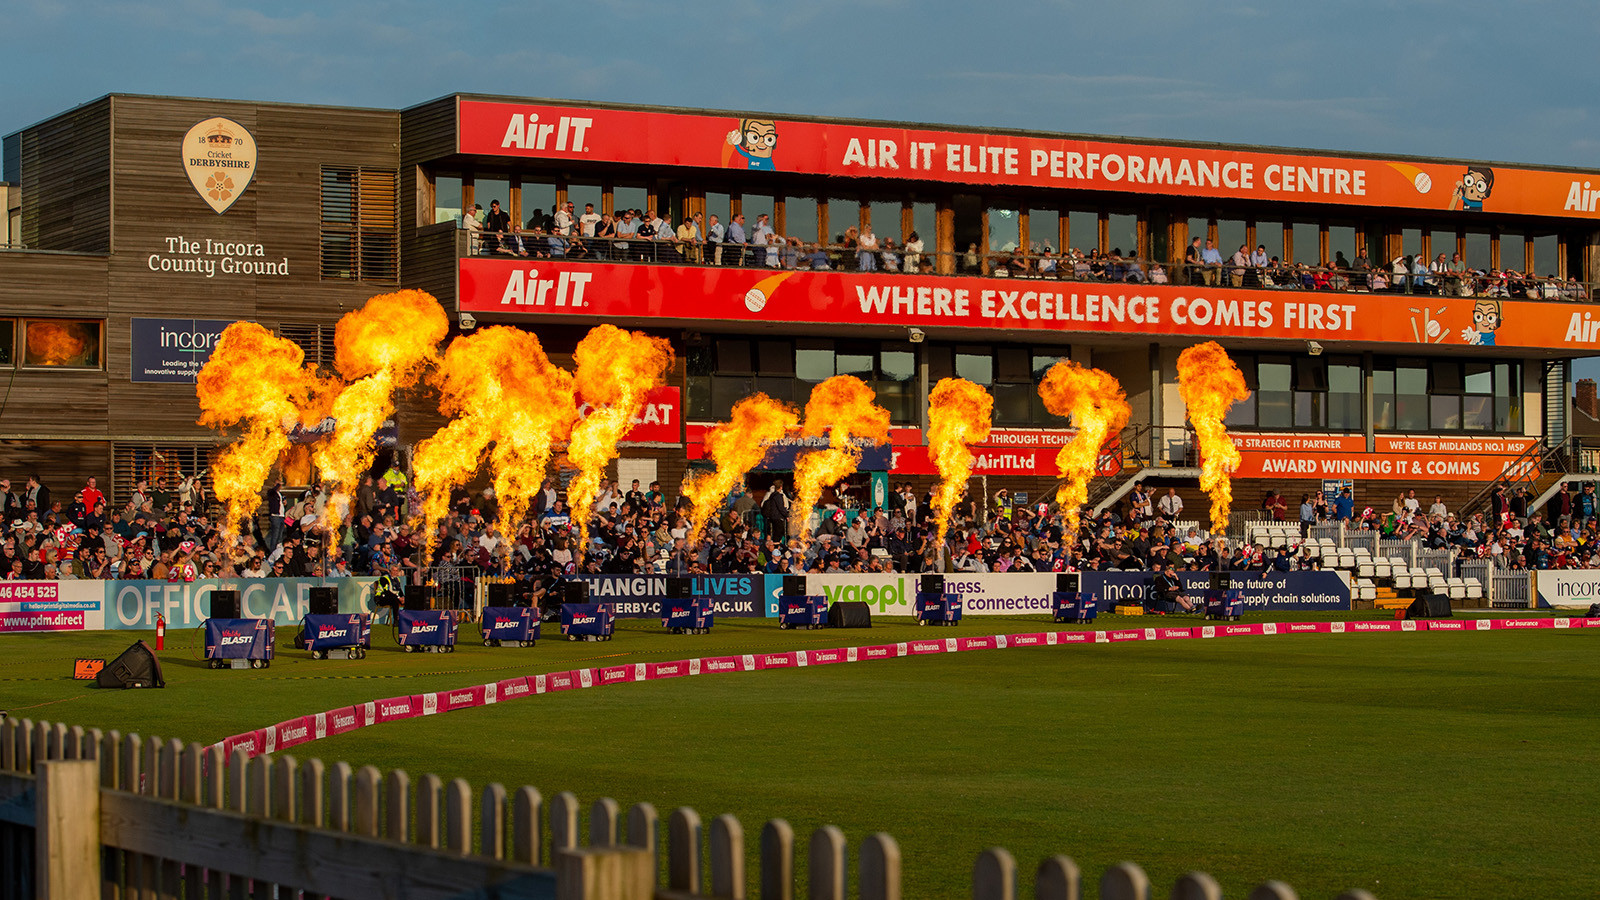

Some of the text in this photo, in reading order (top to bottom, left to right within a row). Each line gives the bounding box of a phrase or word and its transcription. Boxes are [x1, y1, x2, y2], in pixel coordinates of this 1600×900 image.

[198, 136, 206, 144] 18
[207, 151, 232, 159] Cricket
[190, 159, 250, 168] DERBYSHIRE
[842, 138, 1366, 196] AIR IT ELITE PERFORMANCE CENTRE
[165, 236, 265, 257] The Incora
[148, 254, 289, 277] County Ground
[856, 285, 1356, 330] WHERE EXCELLENCE COMES FIRST
[162, 360, 187, 369] Leading
[189, 359, 199, 367] the
[177, 368, 197, 377] supply
[991, 434, 1072, 445] THROUGH TECHN
[1246, 439, 1291, 448] STRATEGIC
[1293, 439, 1300, 448] IT
[1303, 440, 1341, 449] PARTNER
[1390, 441, 1525, 452] WE'RE EAST MIDLANDS NO.1 MSP
[1262, 459, 1480, 475] AWARD WINNING IT & COMMS
[1038, 503, 1046, 512] 4
[57, 529, 65, 542] 6
[1054, 559, 1061, 571] 6
[184, 565, 193, 578] 6
[570, 577, 752, 596] HANGIN LIVES
[915, 578, 985, 593] biness.
[1187, 578, 1287, 589] Lead the future of
[1557, 578, 1600, 596] incor
[14, 586, 35, 598] 454
[37, 586, 57, 598] 525
[117, 583, 238, 626] OFFIC
[967, 594, 1053, 611] connected.
[1244, 593, 1341, 606] upply chain solutions
[28, 602, 96, 611] hello@printdigitalmedia.co.uk
[671, 610, 691, 618] BLAST!
[3, 612, 83, 628] www.pdm.direct
[495, 621, 520, 629] BLAST!
[572, 617, 596, 625] BLAST!
[318, 629, 347, 639] BLAST!
[411, 625, 439, 633] BLAST!
[221, 636, 253, 646] BLAST!
